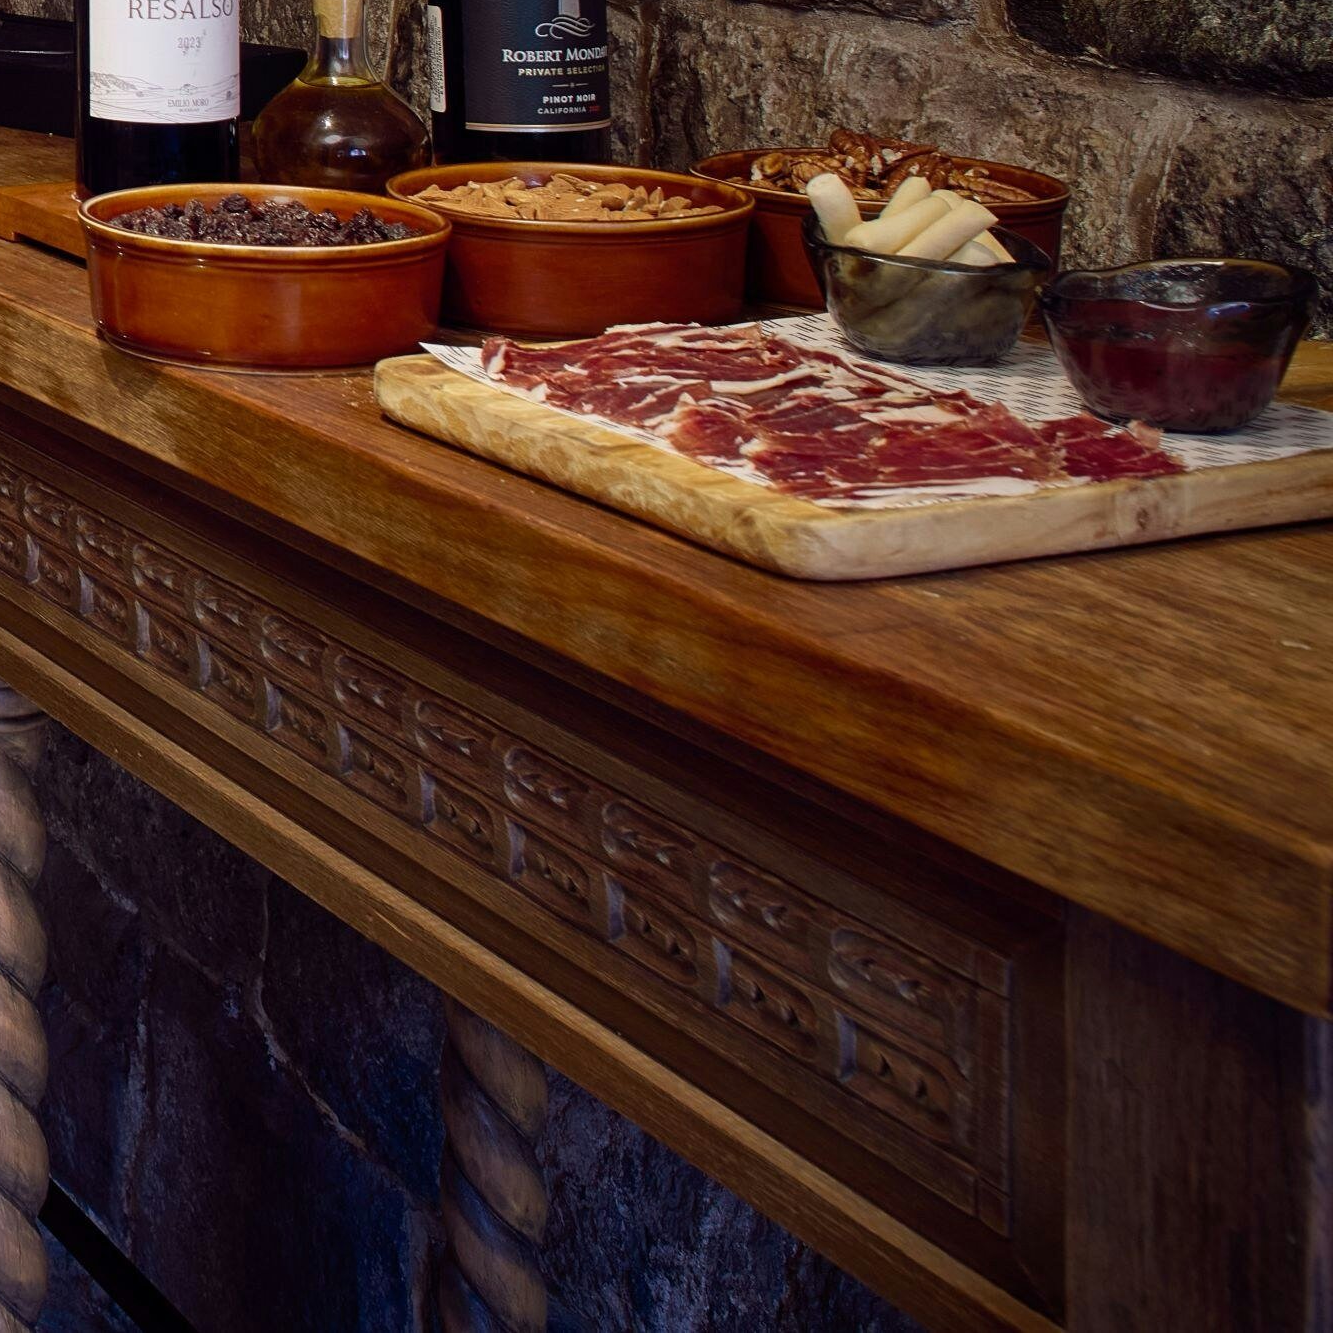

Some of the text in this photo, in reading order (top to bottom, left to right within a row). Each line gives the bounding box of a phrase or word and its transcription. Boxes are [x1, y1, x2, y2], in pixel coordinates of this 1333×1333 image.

[177, 37, 201, 49] 2023
[502, 49, 563, 62] ROBERT
[518, 68, 564, 76] PRIVATE
[543, 93, 596, 104] PINOT NOIR
[537, 106, 587, 114] CALIFORNIA
